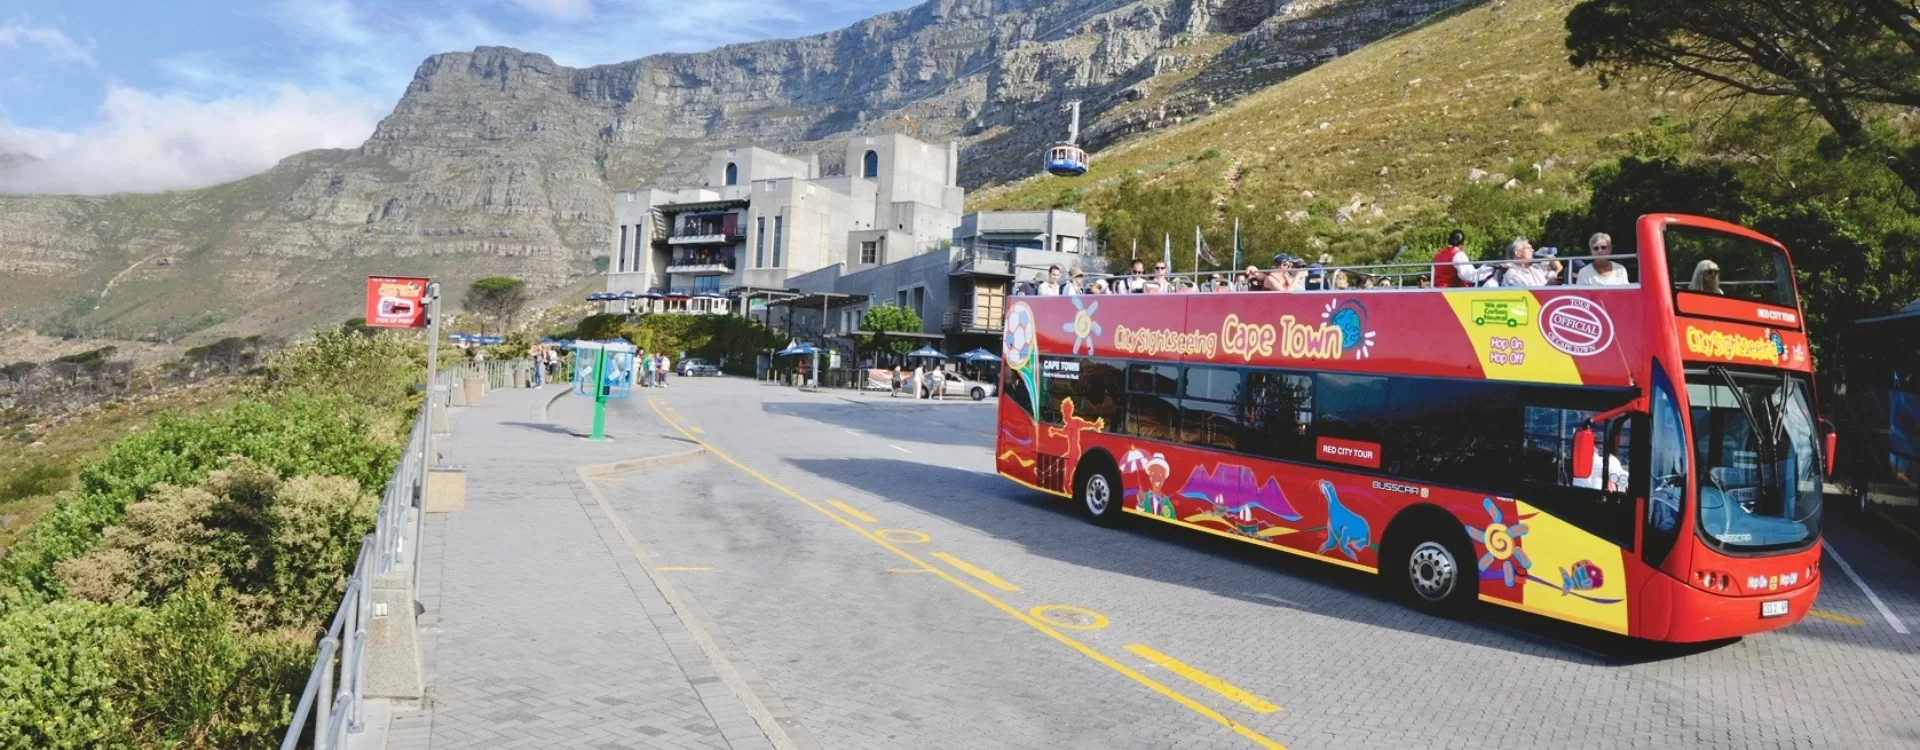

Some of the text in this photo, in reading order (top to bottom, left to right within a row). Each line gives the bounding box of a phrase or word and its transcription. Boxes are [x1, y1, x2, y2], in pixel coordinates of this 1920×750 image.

[1757, 308, 1796, 323] RED CITY TOUR
[1553, 314, 1597, 335] OFFICIAL
[1114, 313, 1342, 361] CitySightseeing Cape Town
[1491, 336, 1524, 351] Hop On
[1548, 331, 1596, 353] OF CAPE TOWN
[1043, 360, 1080, 371] CAPE TOWN
[1489, 351, 1525, 366] Hop Off
[1323, 445, 1373, 459] RED CITY TOUR
[1372, 480, 1419, 495] BUSSCAR
[1747, 576, 1759, 590] Hop
[1759, 575, 1768, 588] On
[1780, 574, 1790, 587] Hop
